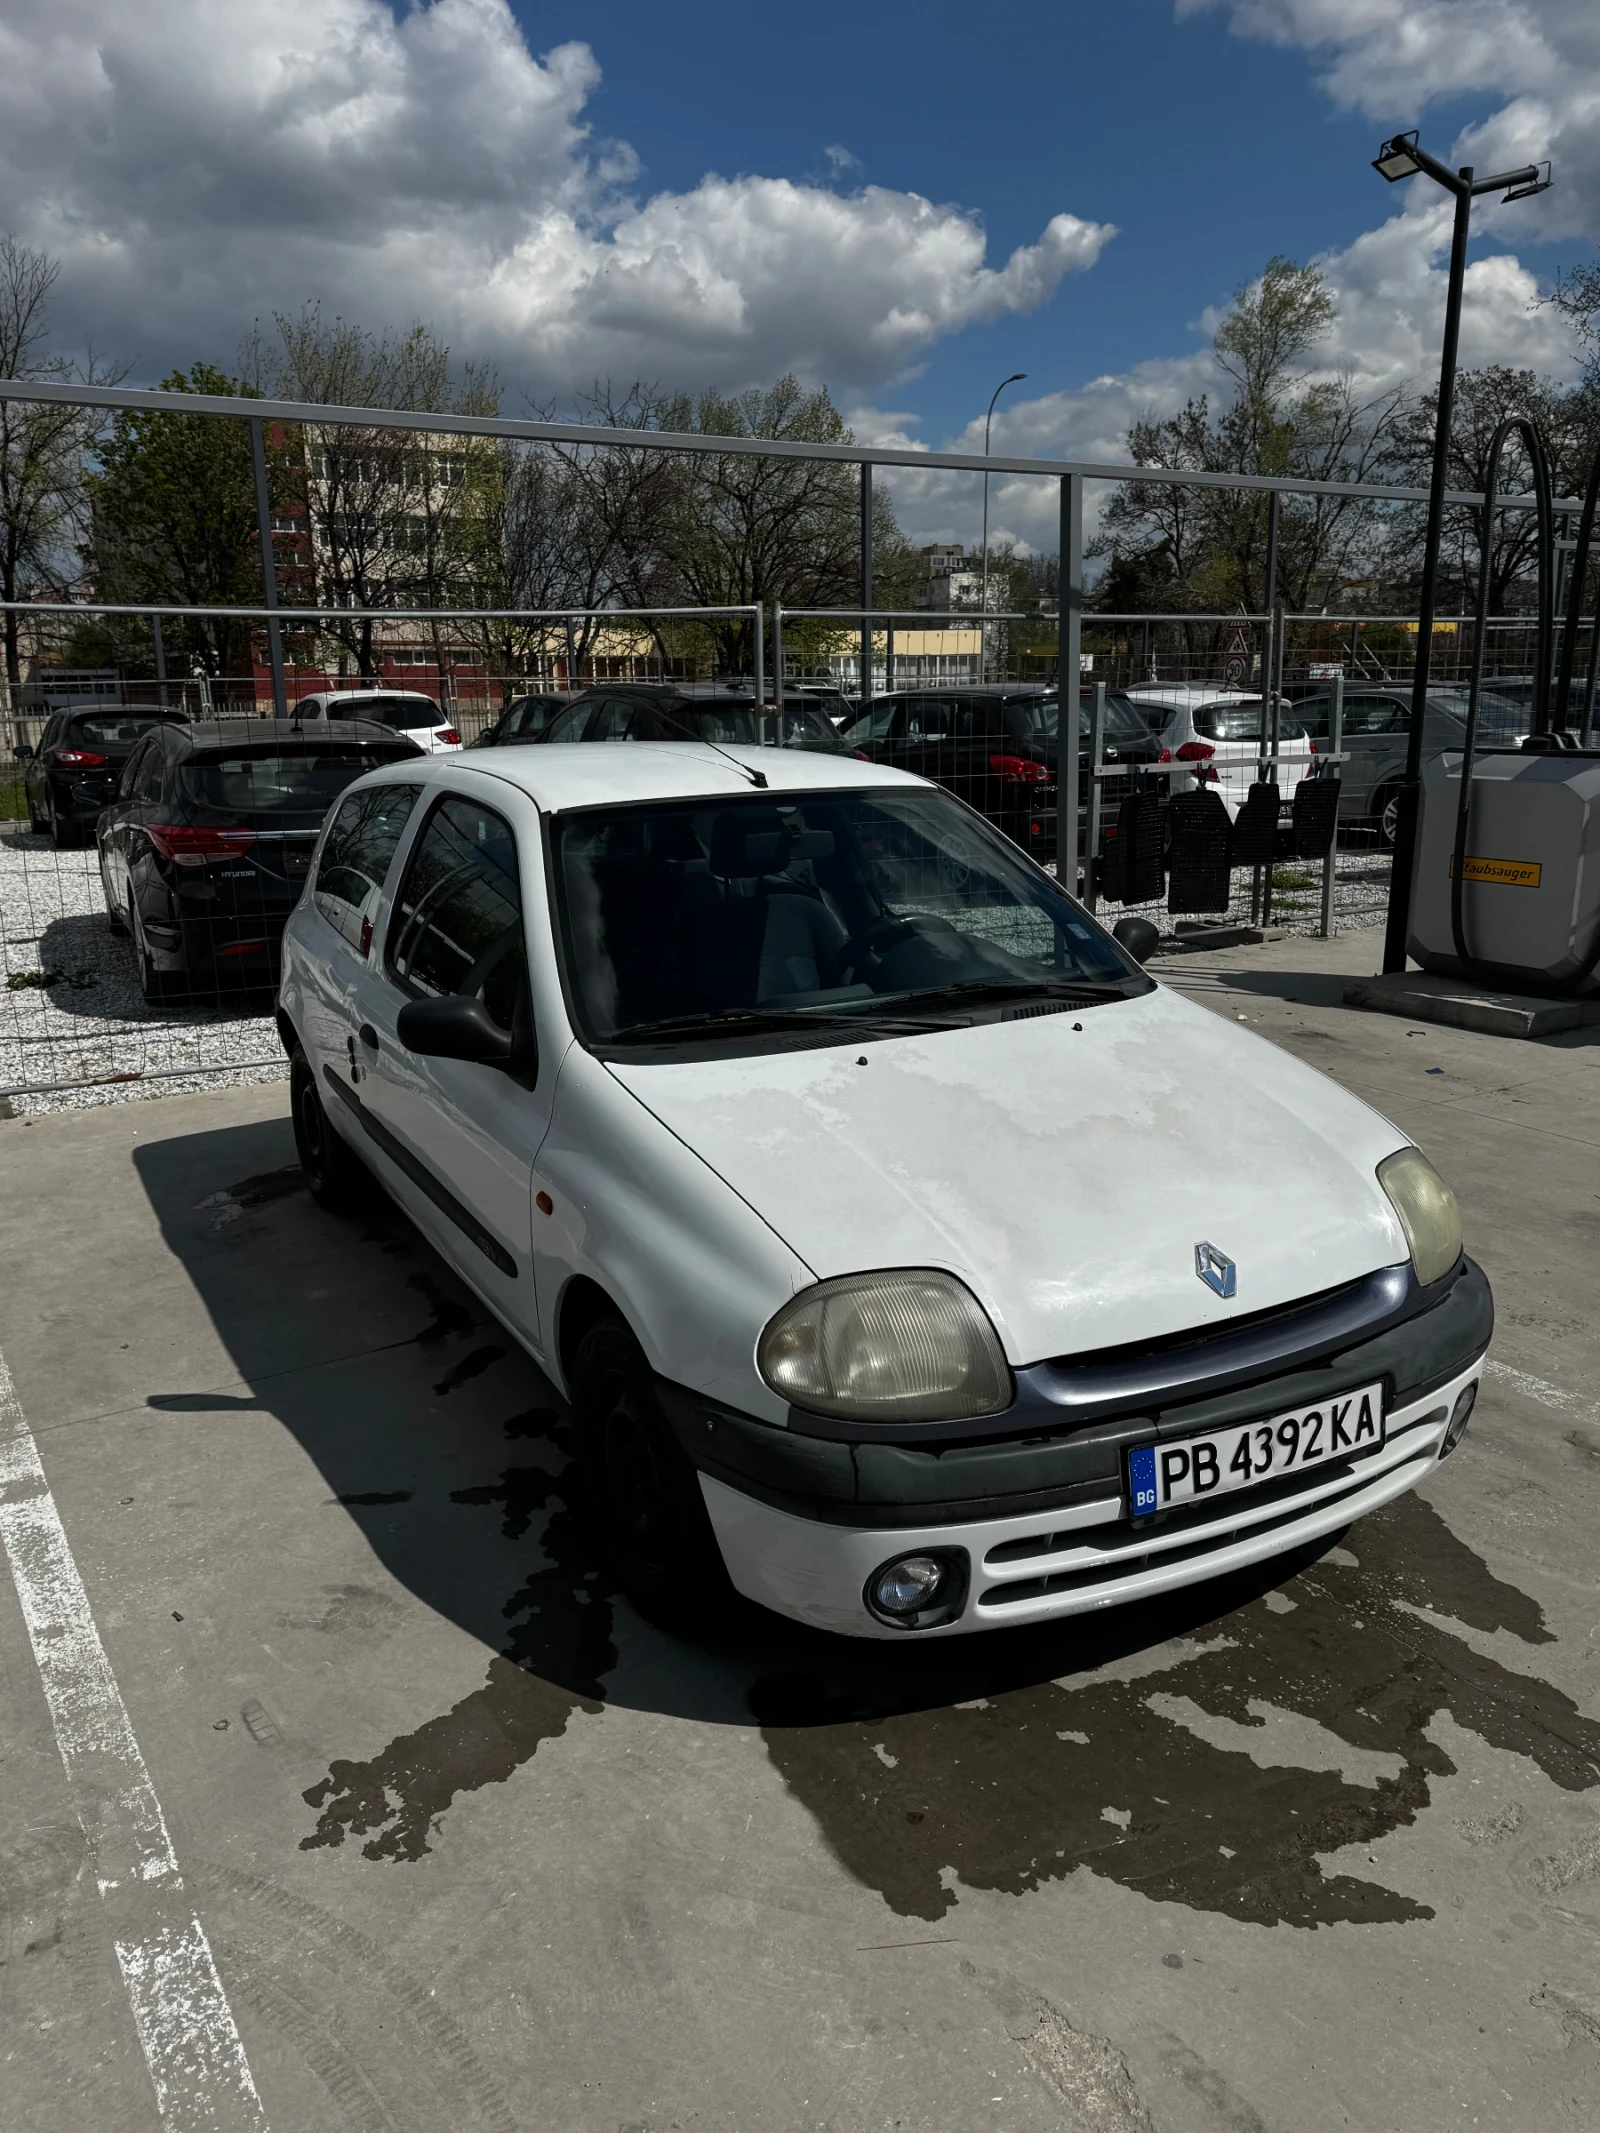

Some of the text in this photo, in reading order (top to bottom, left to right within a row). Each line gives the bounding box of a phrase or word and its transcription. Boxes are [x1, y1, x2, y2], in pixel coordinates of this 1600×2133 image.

[1462, 861, 1534, 880] taubsauger
[1162, 1393, 1375, 1502] PB 4392 KA
[1137, 1489, 1155, 1507] BG
